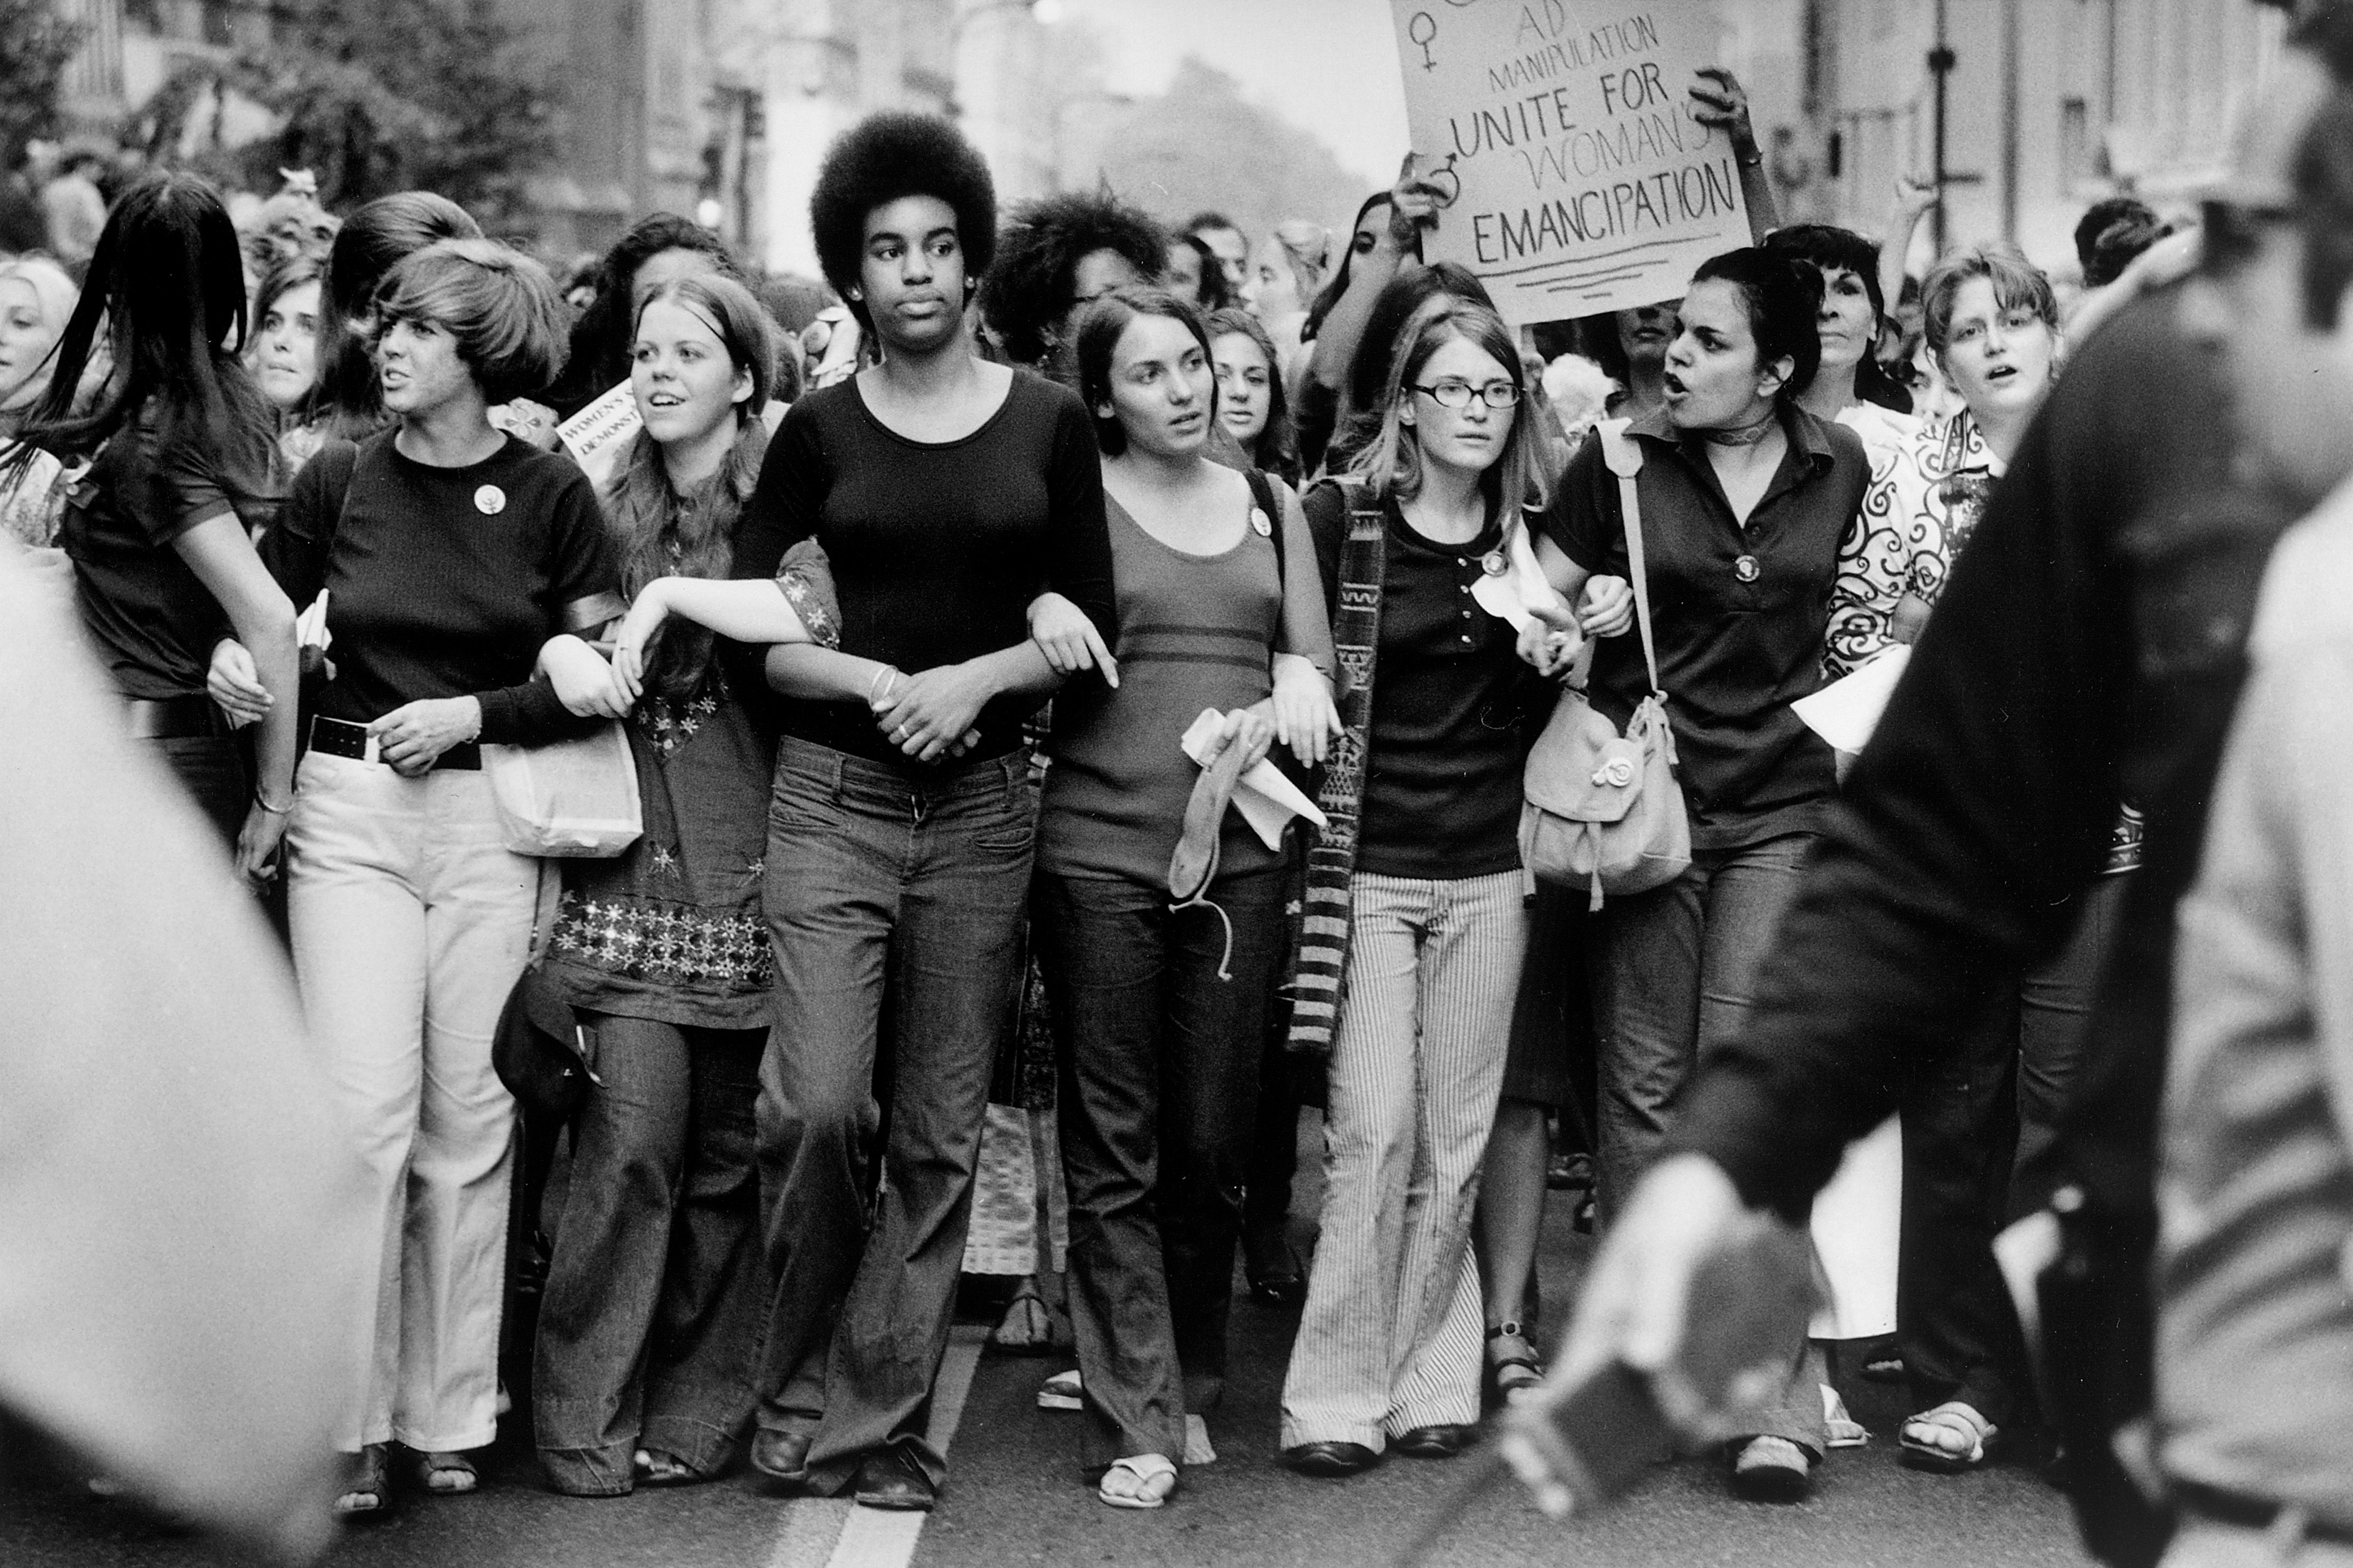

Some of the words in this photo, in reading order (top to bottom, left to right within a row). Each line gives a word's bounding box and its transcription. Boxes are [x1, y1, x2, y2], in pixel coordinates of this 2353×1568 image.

[1488, 13, 1660, 93] MANIPULATION
[1450, 88, 1575, 157] UNITE
[1600, 62, 1669, 115] FOR
[1514, 101, 1710, 190] WOMAN'S
[1473, 160, 1734, 263] EMANCIPATION
[580, 410, 638, 454] DEMONST
